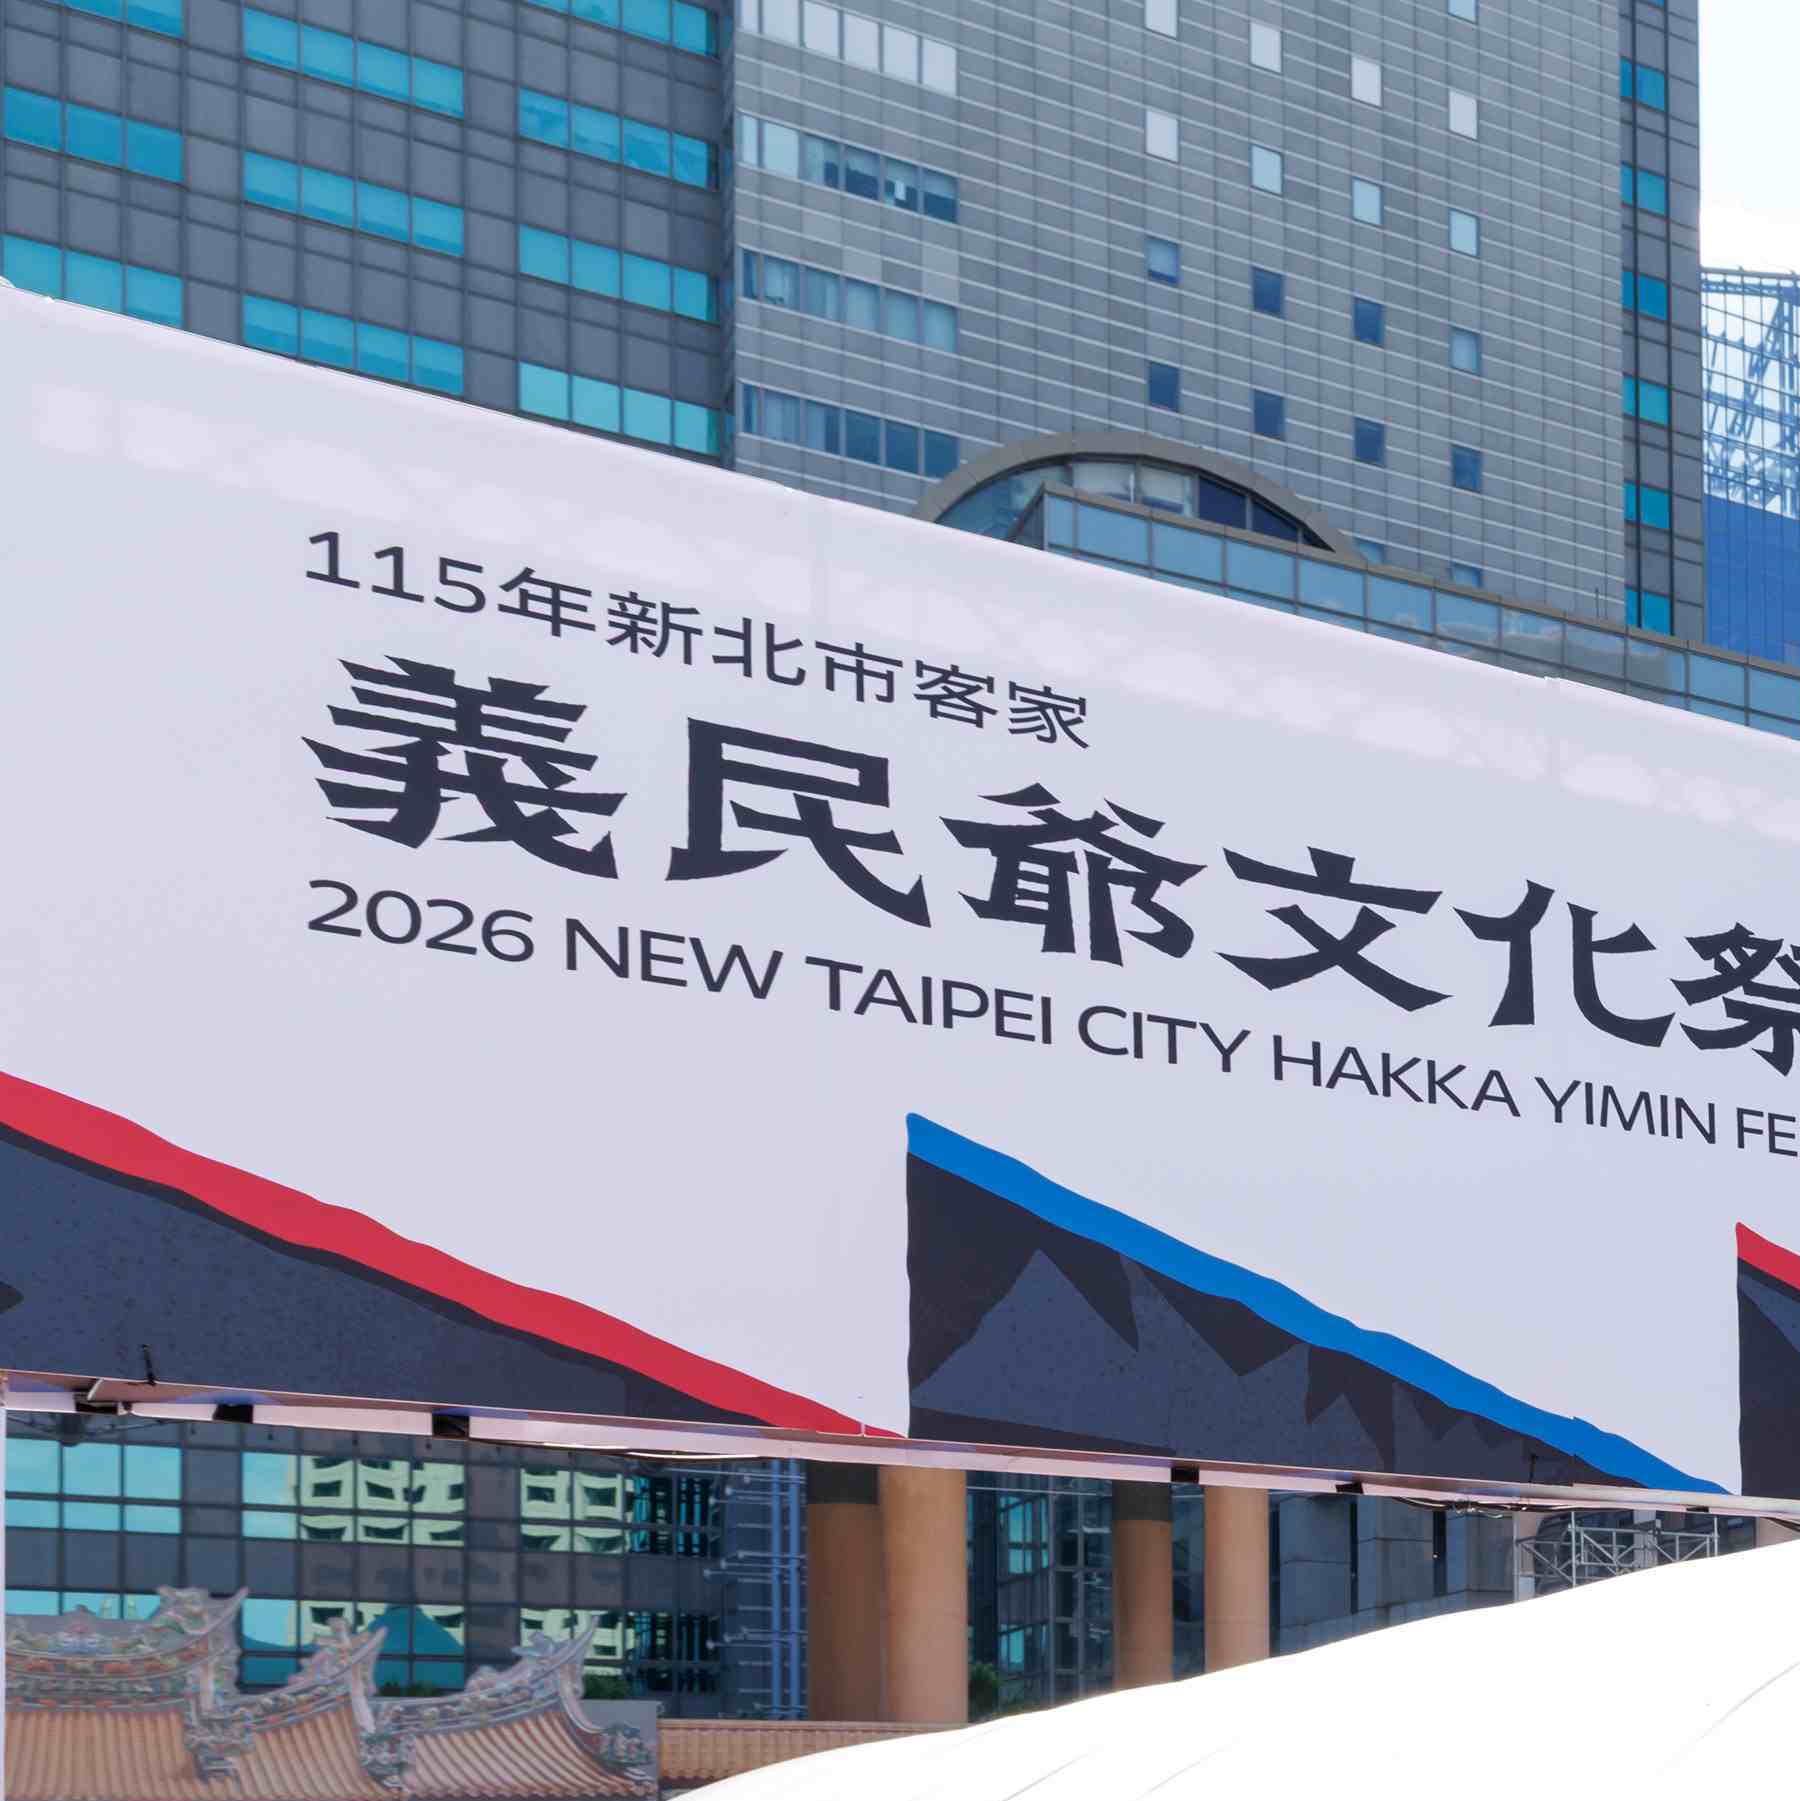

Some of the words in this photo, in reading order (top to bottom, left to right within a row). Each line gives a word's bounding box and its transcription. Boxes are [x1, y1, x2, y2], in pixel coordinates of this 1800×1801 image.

[307, 532, 1089, 749] 115年新北市客家
[308, 879, 534, 962] 2026
[566, 918, 784, 1000] NEW
[805, 956, 1052, 1045] TAIPEI
[1078, 1005, 1251, 1073] CITY
[1273, 1034, 1521, 1118] HAKKA
[1534, 1076, 1716, 1145] YIMIN
